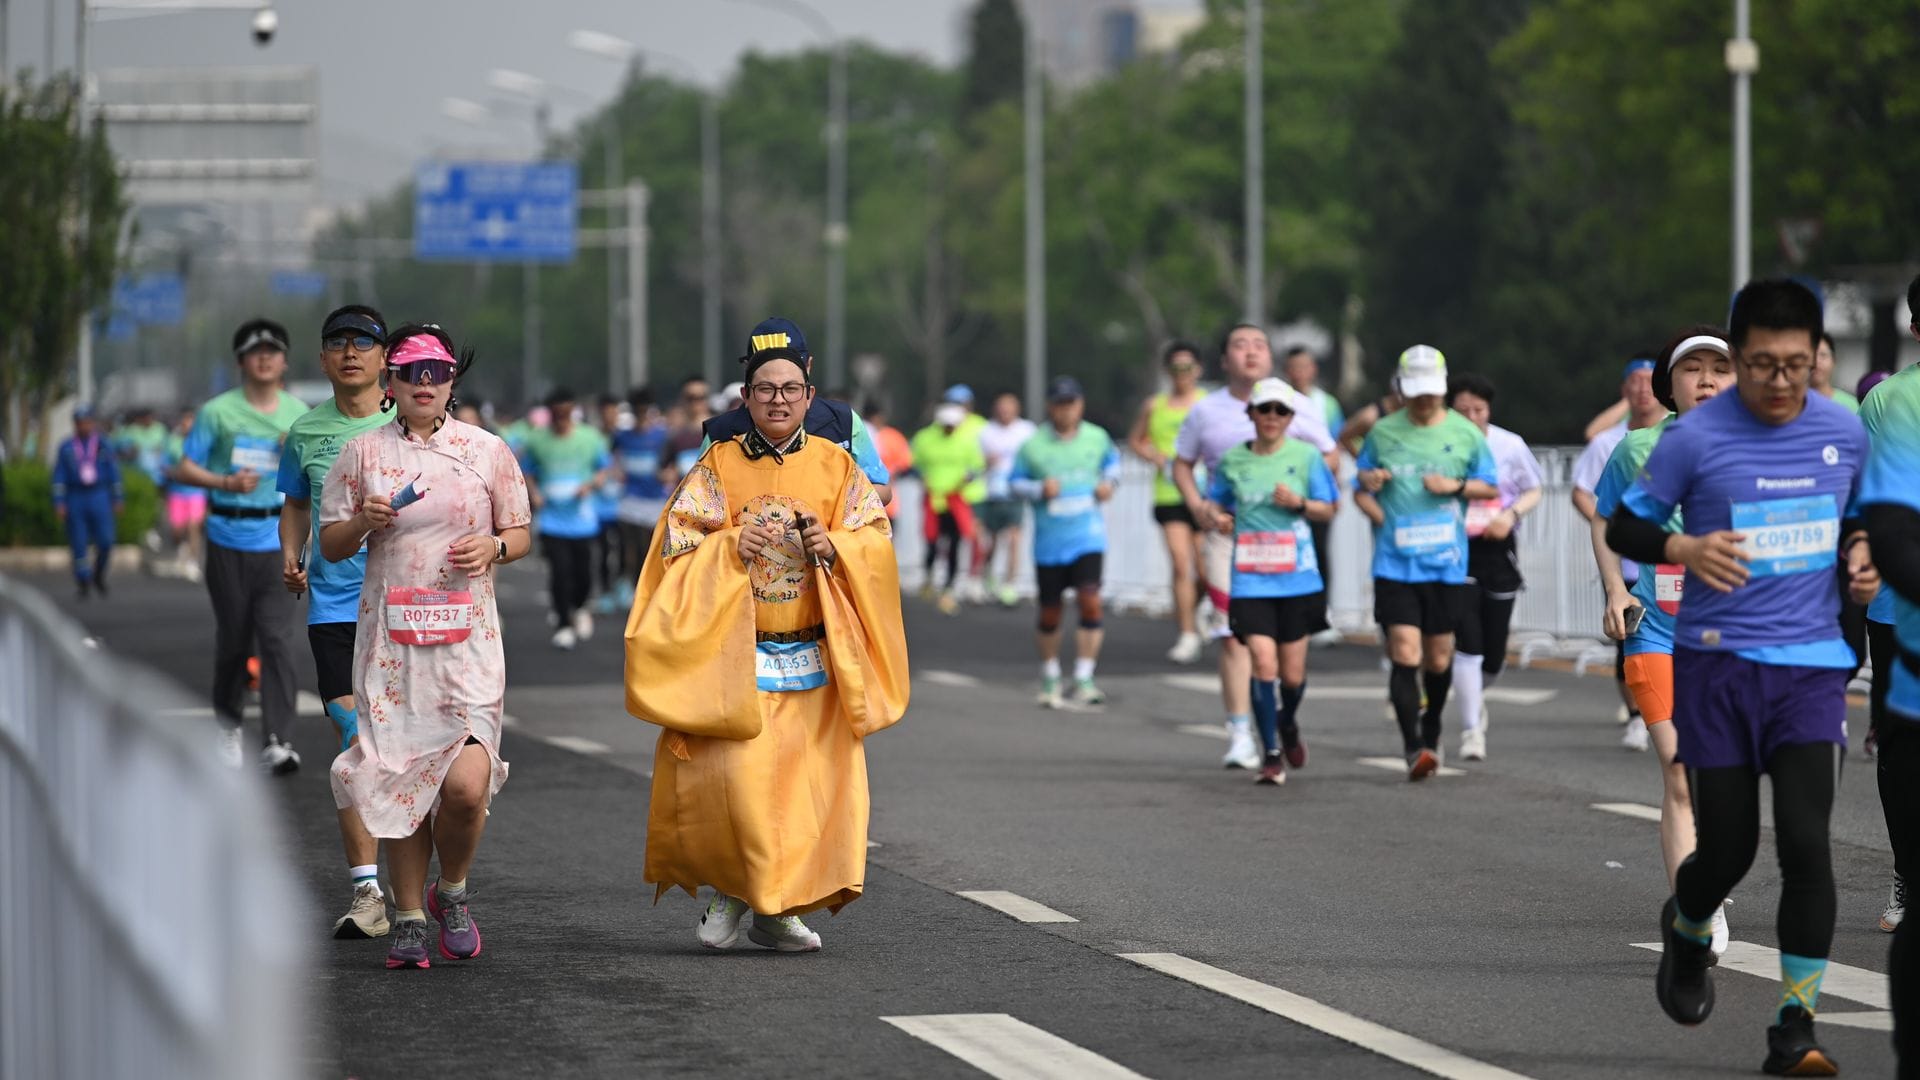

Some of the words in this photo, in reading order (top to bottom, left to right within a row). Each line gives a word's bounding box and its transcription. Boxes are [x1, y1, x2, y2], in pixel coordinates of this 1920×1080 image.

[1757, 477, 1816, 490] Panasonic
[1755, 527, 1824, 548] C09789
[403, 609, 460, 622] B07537
